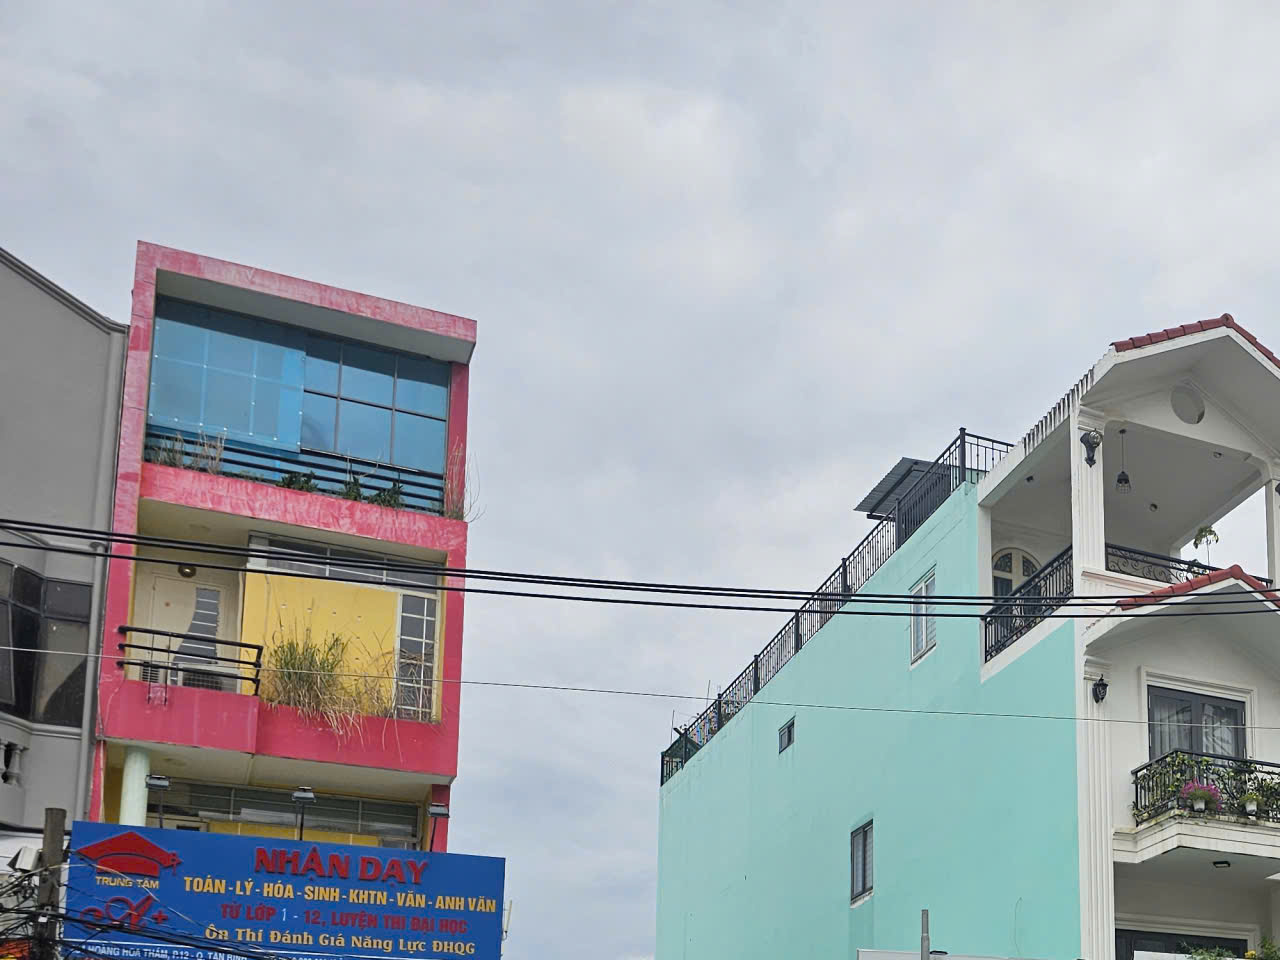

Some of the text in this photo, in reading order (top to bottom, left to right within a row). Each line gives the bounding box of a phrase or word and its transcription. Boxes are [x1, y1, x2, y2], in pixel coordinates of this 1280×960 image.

[96, 875, 160, 889] TRUNG TÂM
[255, 845, 428, 887] NHẬN DẠY
[184, 874, 496, 913] TOÁN LÝ HÓA SINH KHTN VĂN ANH VĂN
[383, 914, 406, 930] THI
[205, 923, 229, 941] Ôn
[269, 930, 313, 945] Đánh
[351, 935, 393, 952] Năng
[399, 938, 426, 953] Lực
[432, 940, 476, 955] ĐHQG
